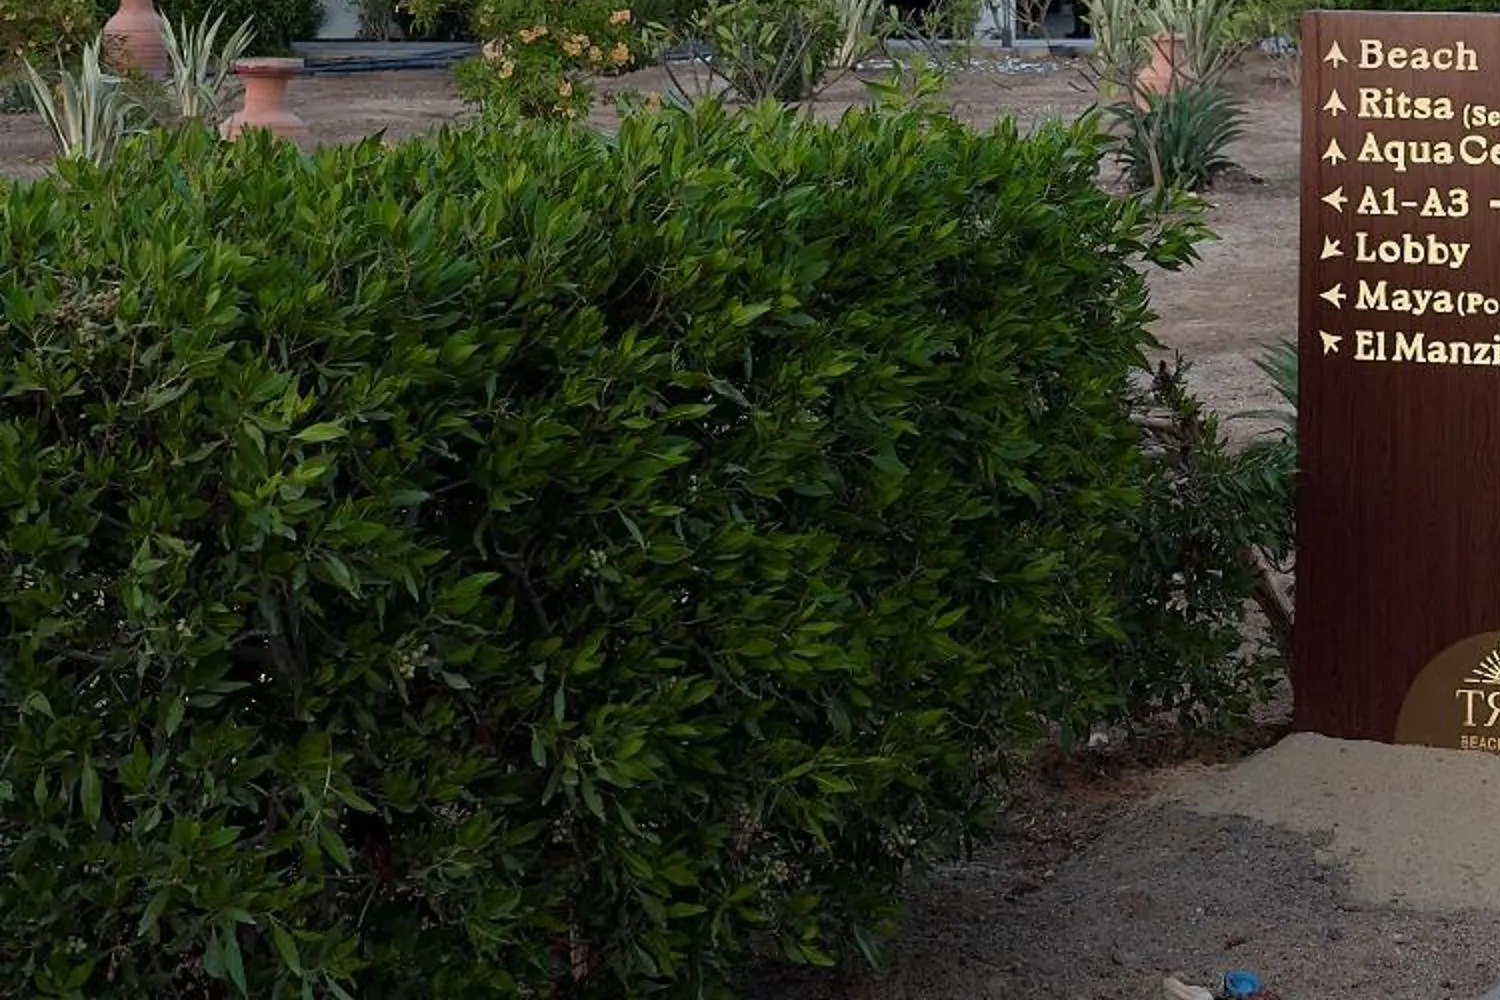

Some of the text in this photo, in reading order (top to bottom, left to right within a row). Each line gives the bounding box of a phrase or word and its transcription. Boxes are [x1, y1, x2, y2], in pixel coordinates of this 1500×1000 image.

[1358, 39, 1479, 71] Beach
[1357, 87, 1455, 120] Ritsa
[1357, 132, 1455, 172] Aqua
[1357, 185, 1469, 218] A1-A3
[1355, 232, 1471, 269] Lobby
[1355, 279, 1454, 316] Maya
[1354, 330, 1387, 361] El
